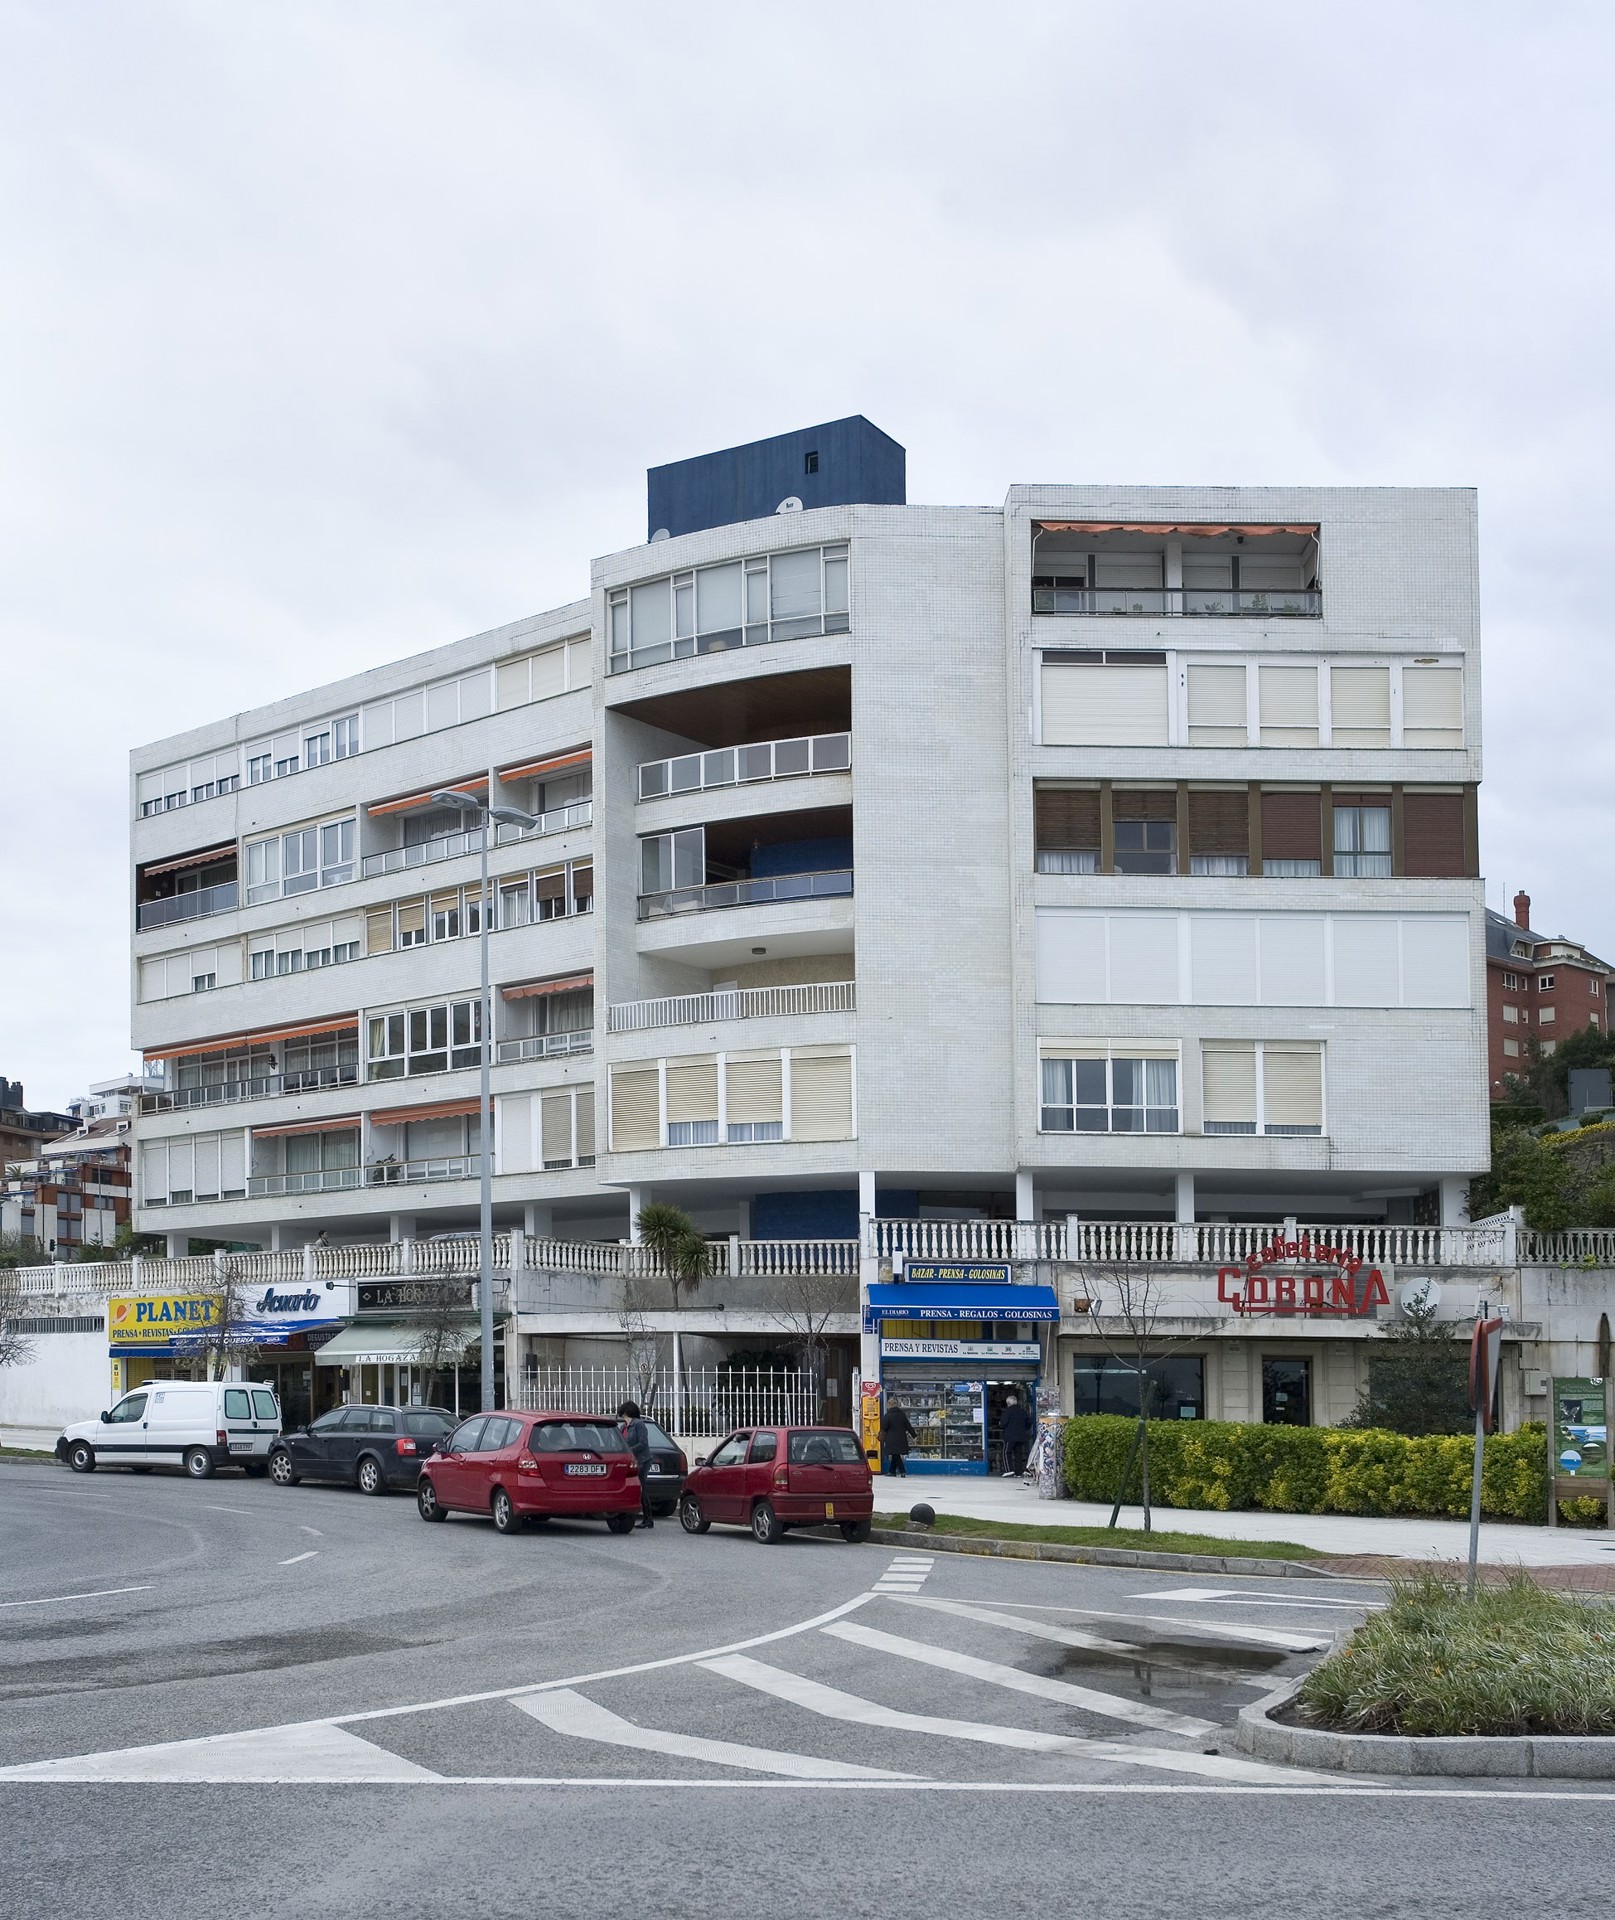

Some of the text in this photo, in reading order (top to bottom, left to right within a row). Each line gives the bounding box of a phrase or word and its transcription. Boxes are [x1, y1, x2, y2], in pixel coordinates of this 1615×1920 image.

[911, 1268, 933, 1279] BAZAR
[938, 1268, 964, 1279] PRENSA
[968, 1268, 1006, 1280] GOLOSINAS
[376, 1286, 448, 1305] LA HOGAZ
[1217, 1267, 1390, 1314] CORONA
[256, 1287, 321, 1313] Acuario
[136, 1300, 214, 1322] PLANET
[920, 1309, 952, 1318] PRENSA
[959, 1310, 998, 1318] REGALOS
[1004, 1310, 1053, 1319] GOLOSINAS
[112, 1329, 138, 1338] PRENSA
[142, 1327, 174, 1338] REVISTAS
[307, 1333, 340, 1341] DEGUSTAC
[884, 1342, 959, 1354] PRENSA Y REVISTAS
[376, 1354, 416, 1362] HOGAZA
[569, 1465, 588, 1473] 2283
